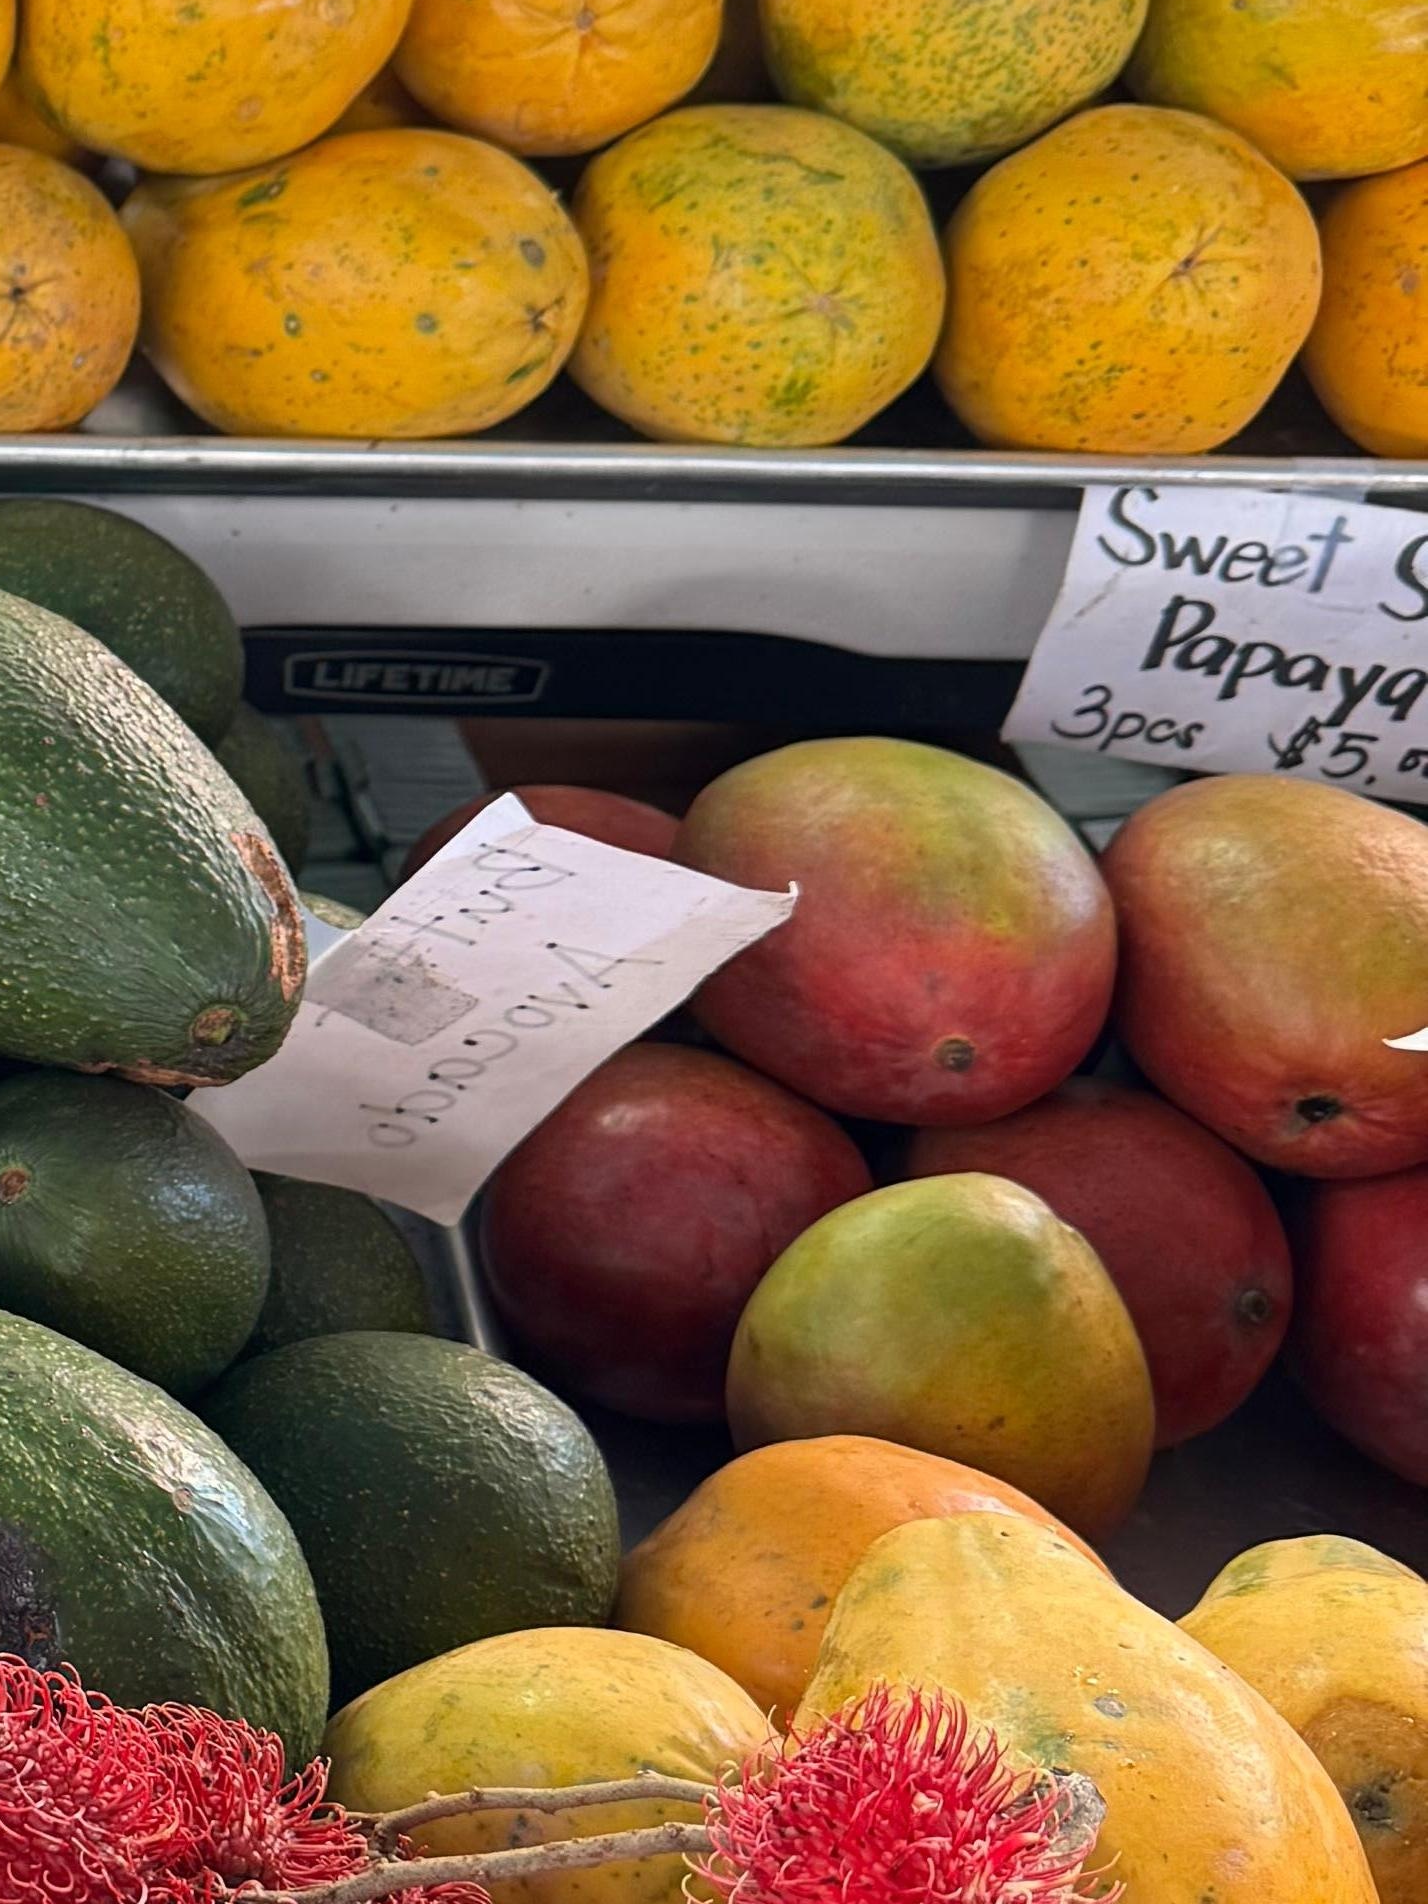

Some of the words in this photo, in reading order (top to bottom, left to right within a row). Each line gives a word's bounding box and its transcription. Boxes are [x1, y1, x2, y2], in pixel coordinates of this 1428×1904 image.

[1097, 486, 1355, 593] Sweet
[313, 660, 518, 693] LIFETIME
[1141, 595, 1428, 728] Papaya
